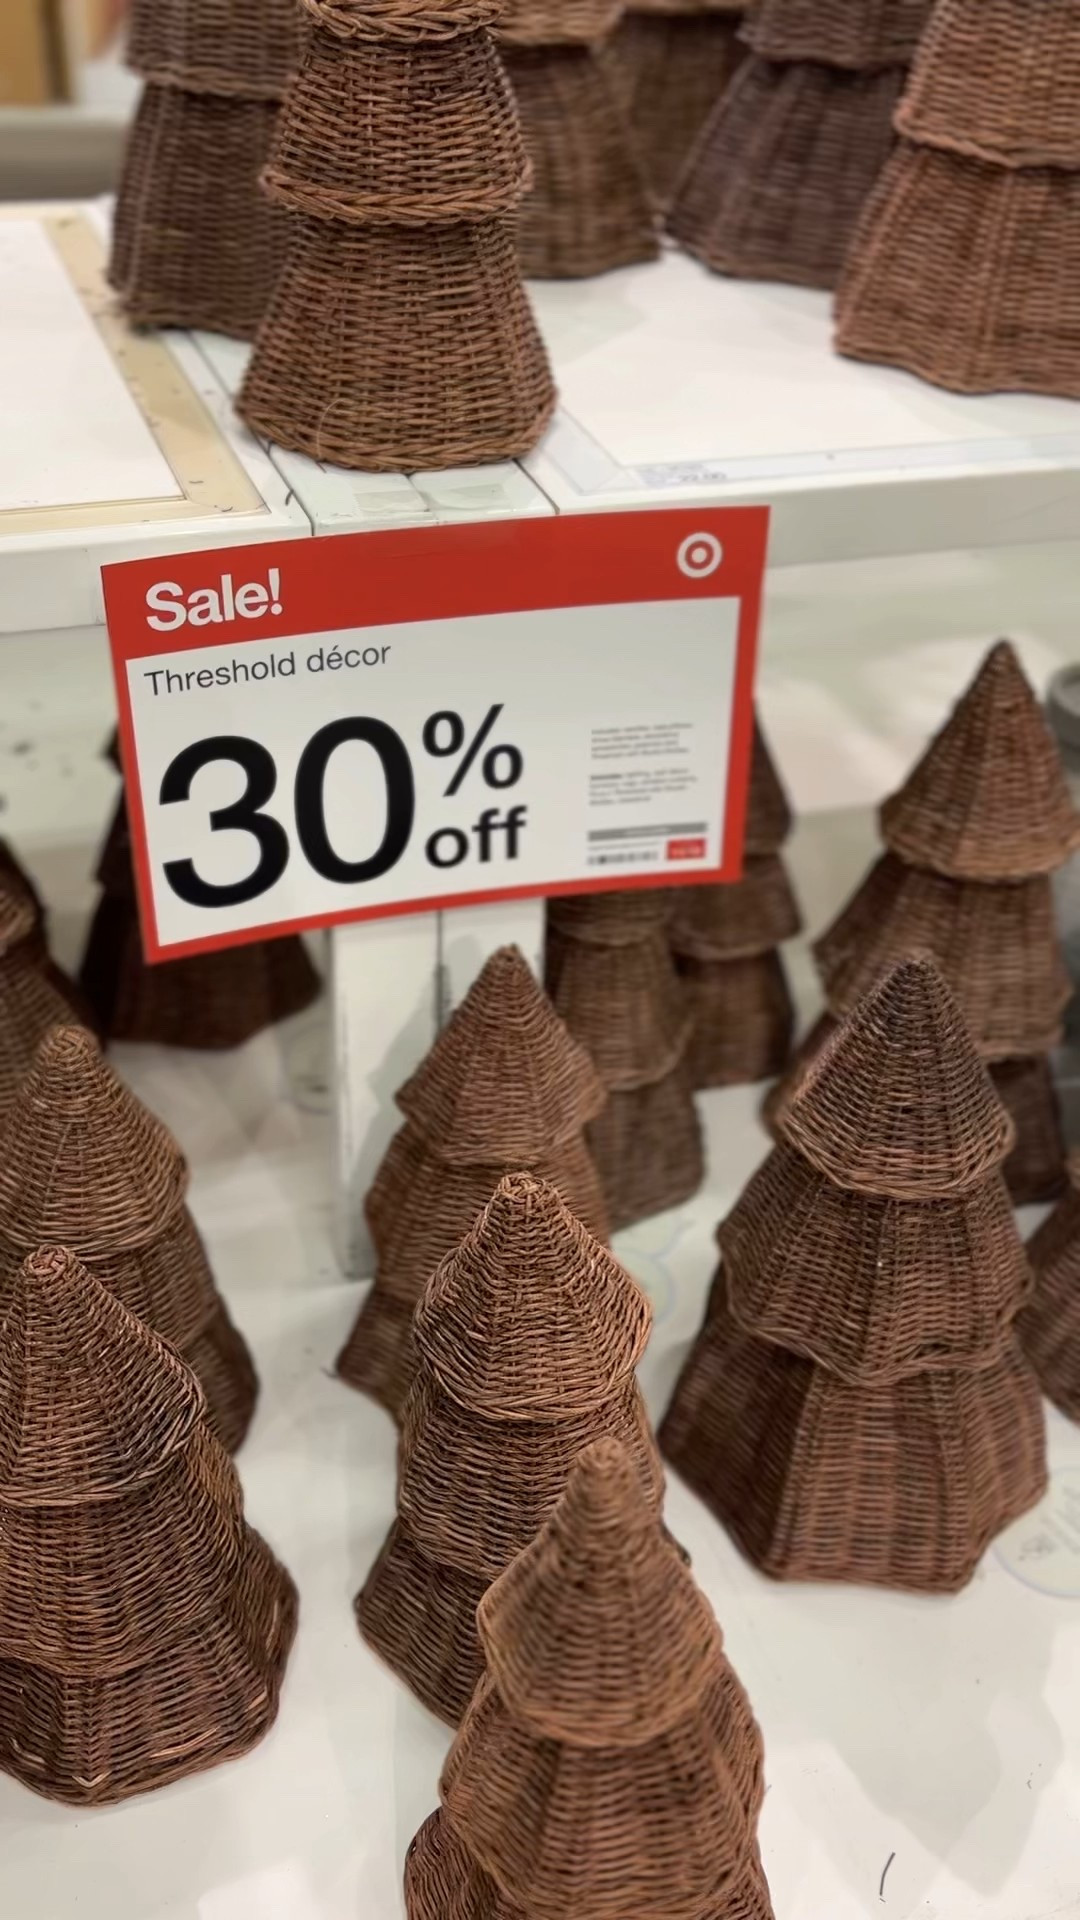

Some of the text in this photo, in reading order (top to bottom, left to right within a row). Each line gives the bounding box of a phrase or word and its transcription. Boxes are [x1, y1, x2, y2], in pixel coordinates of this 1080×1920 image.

[145, 567, 283, 632] Sale!
[143, 645, 391, 696] Threshold décor
[424, 805, 528, 869] off
